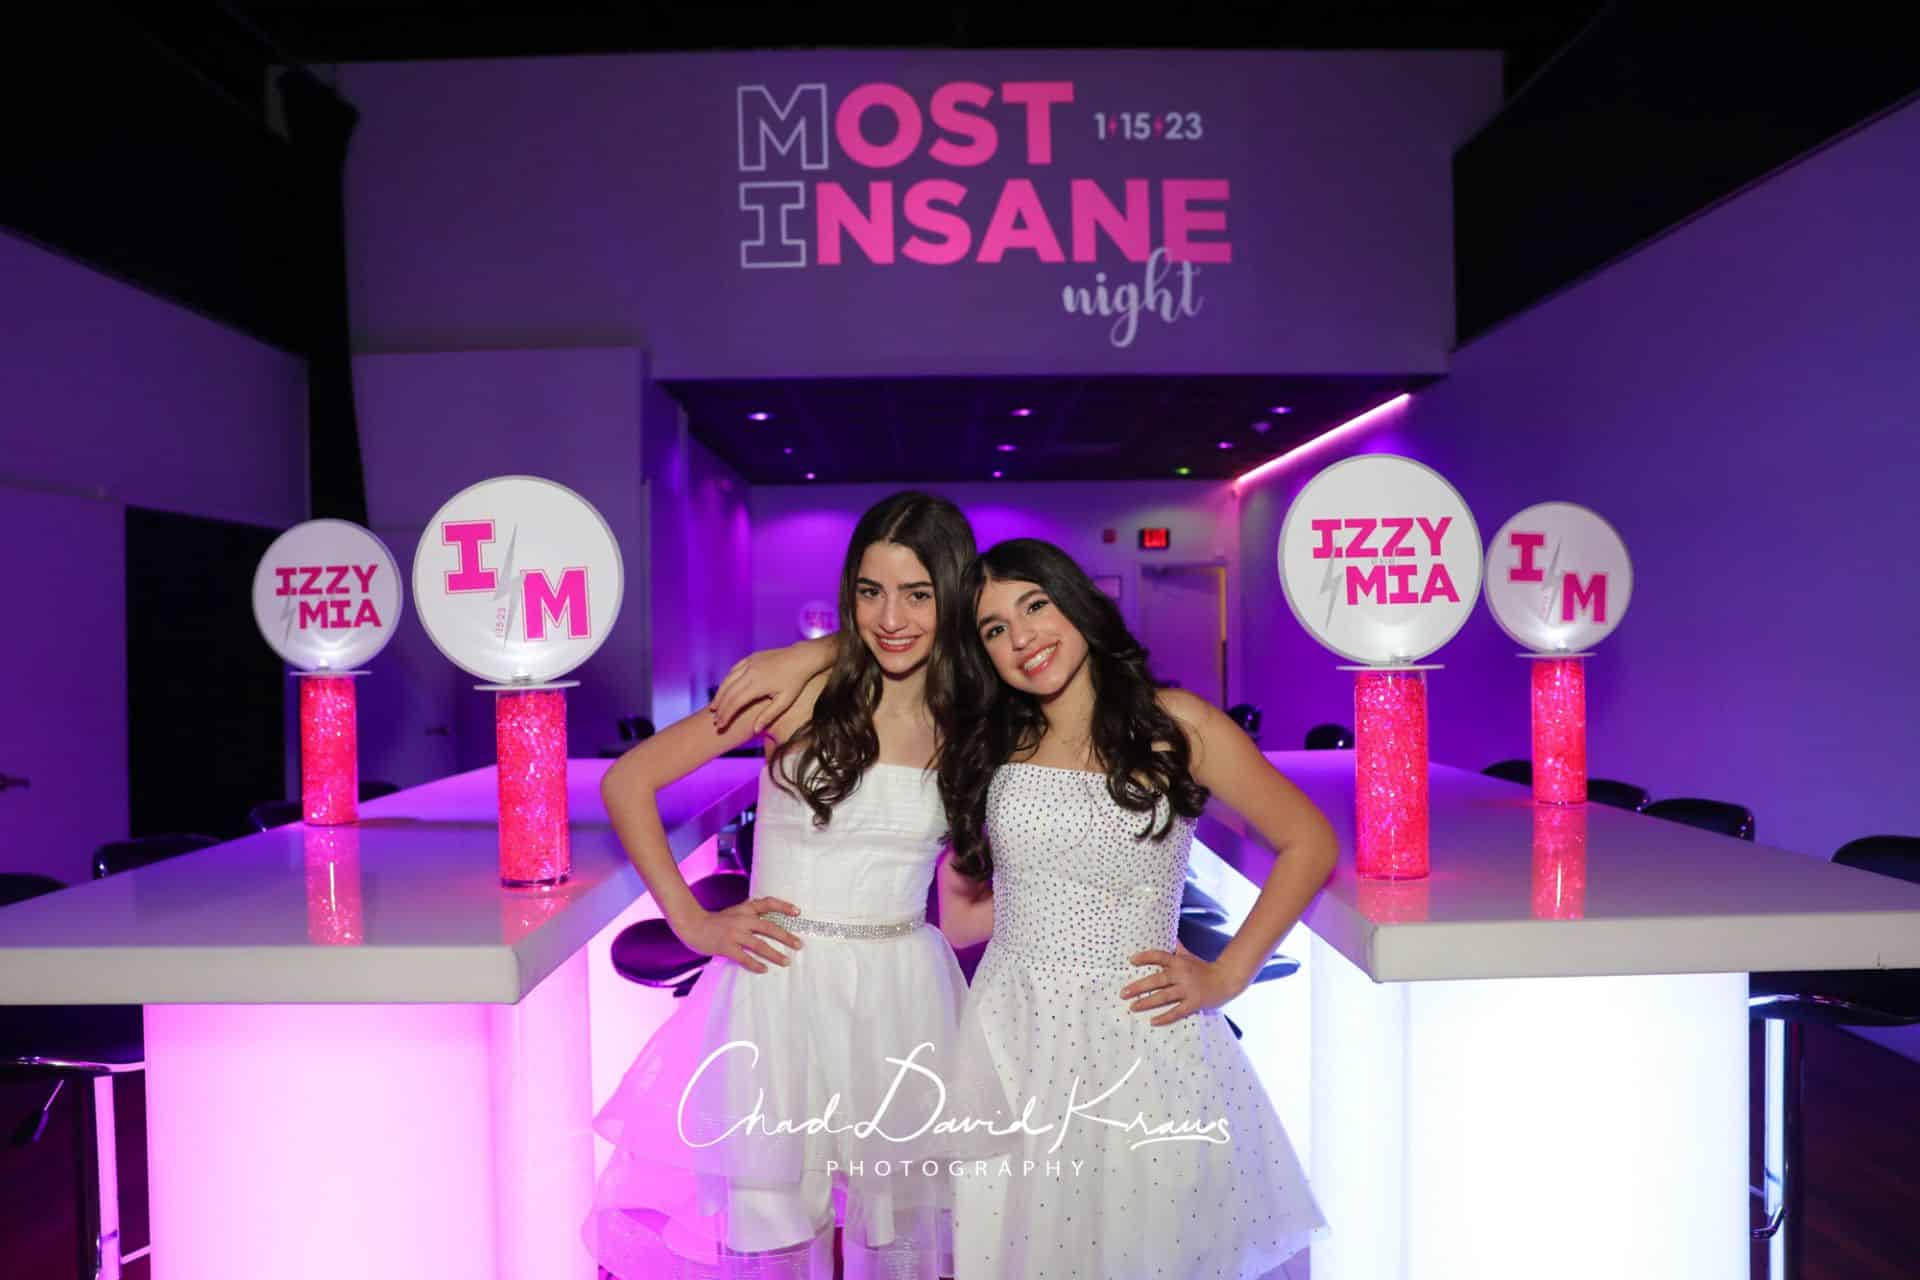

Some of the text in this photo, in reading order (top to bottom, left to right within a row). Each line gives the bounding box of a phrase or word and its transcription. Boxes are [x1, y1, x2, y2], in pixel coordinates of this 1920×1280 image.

[737, 81, 1074, 171] MOST
[740, 179, 1232, 268] INSANE
[1062, 247, 1203, 348] night
[275, 564, 378, 596] IZZY
[441, 519, 497, 594] I
[520, 566, 592, 641] M
[1312, 517, 1453, 558] IZZY
[1510, 533, 1546, 582] I
[1561, 572, 1607, 622] M
[299, 599, 382, 630] MIA
[1345, 563, 1460, 606] MIA
